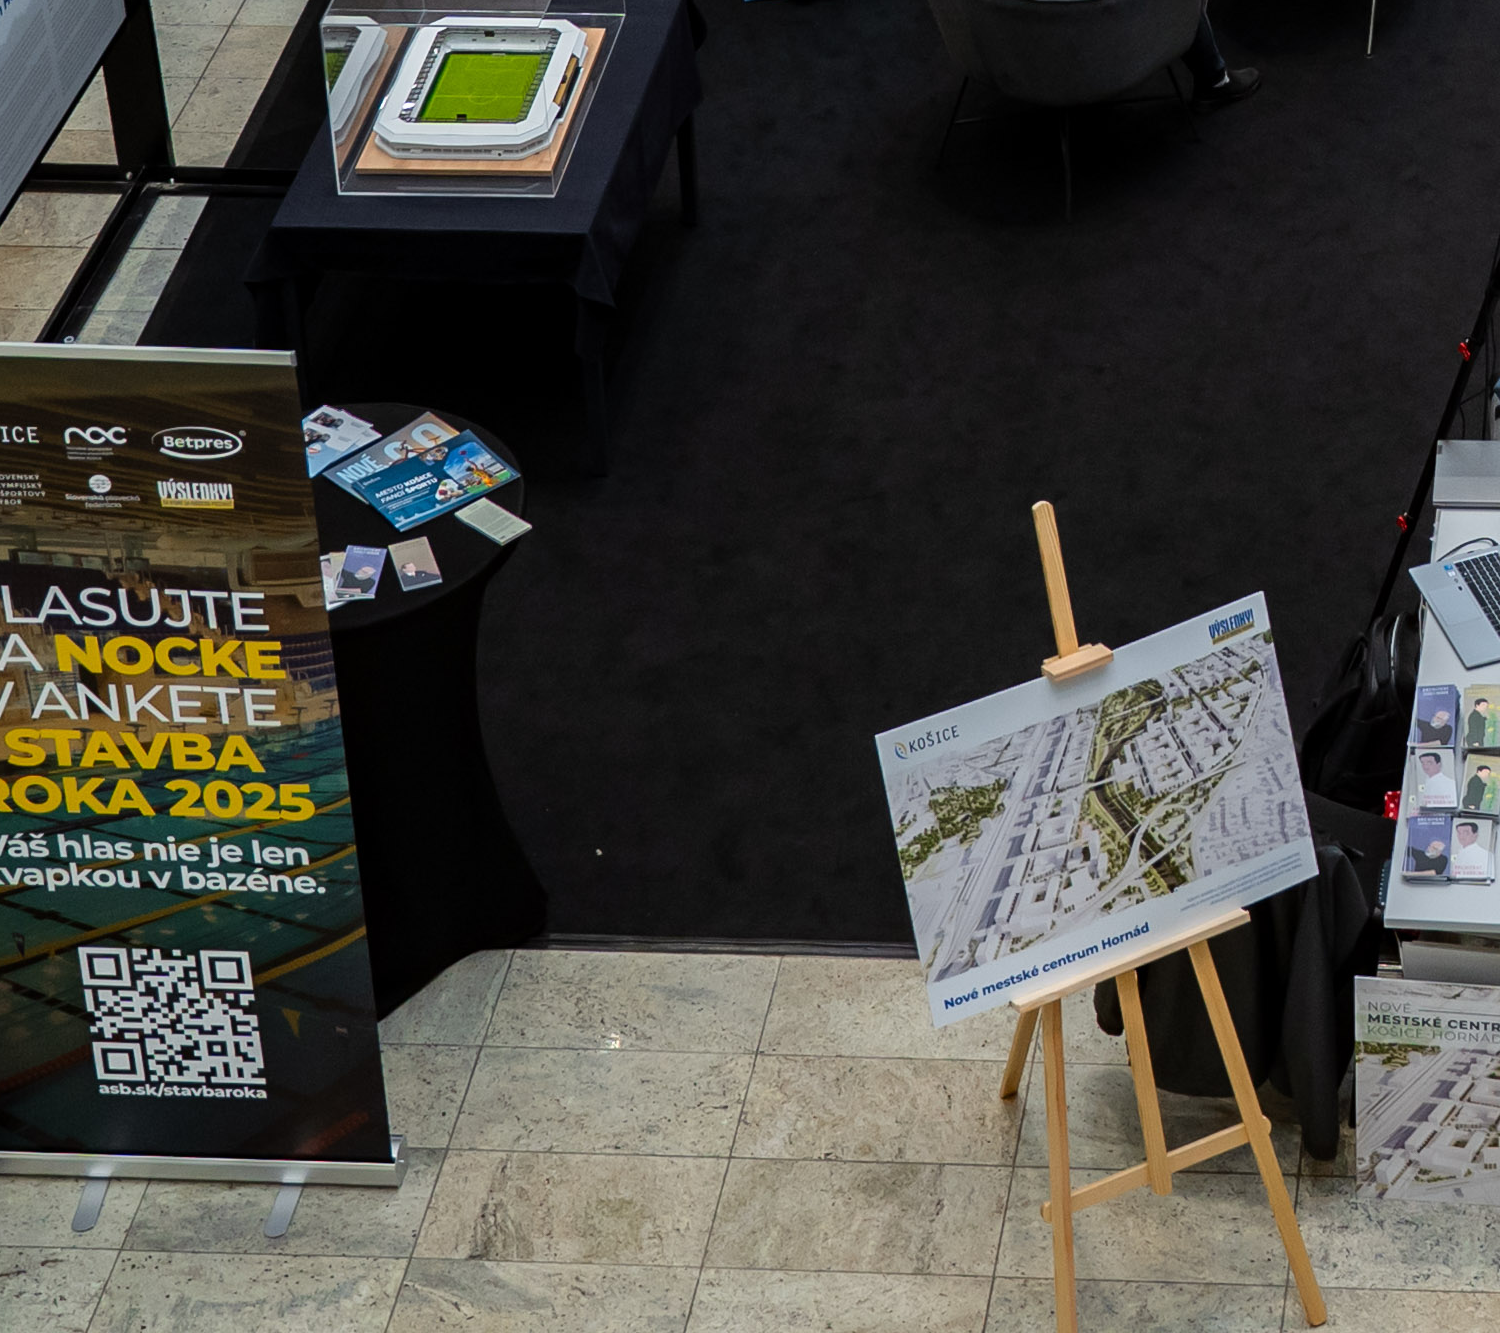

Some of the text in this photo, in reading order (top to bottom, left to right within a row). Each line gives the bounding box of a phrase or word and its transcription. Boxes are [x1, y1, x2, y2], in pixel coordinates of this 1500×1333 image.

[163, 436, 233, 450] Betpres
[336, 454, 380, 483] NOVÉ
[55, 636, 286, 679] NOCKE
[31, 685, 281, 728] ANKETE
[6, 728, 265, 773] STAVBA
[909, 725, 960, 754] KOŠICE
[169, 780, 315, 822] 2025
[58, 833, 133, 863] hlas
[142, 837, 197, 865] nie
[205, 839, 244, 870] je
[251, 840, 309, 866] len
[148, 871, 174, 891] v
[182, 864, 326, 895] bazéne.
[944, 922, 1150, 1010] Nové mestské centrum Hornád
[1368, 1001, 1412, 1014] NOVÉ
[1368, 1013, 1442, 1029] MESTSKÉ
[99, 1082, 267, 1102] asb.sk/stavbaroka
